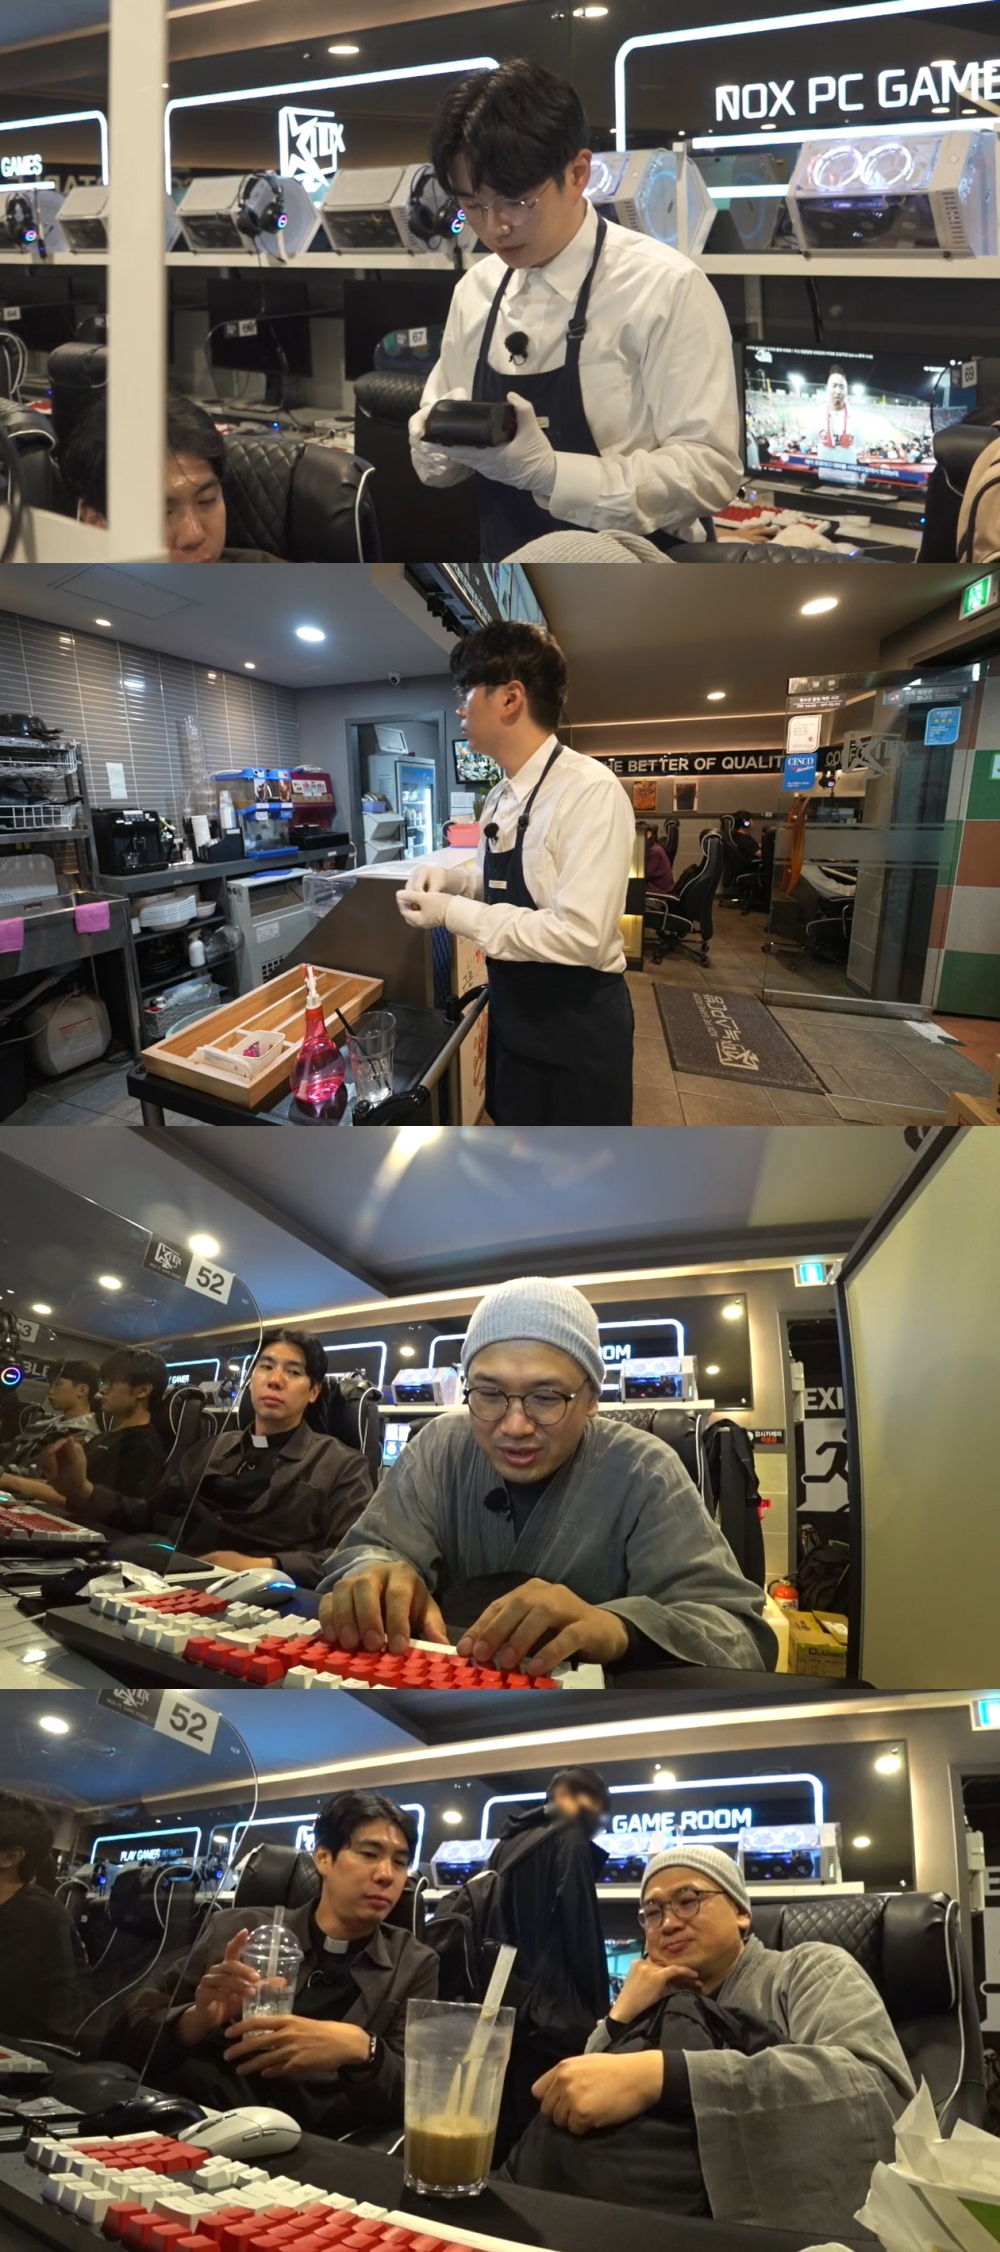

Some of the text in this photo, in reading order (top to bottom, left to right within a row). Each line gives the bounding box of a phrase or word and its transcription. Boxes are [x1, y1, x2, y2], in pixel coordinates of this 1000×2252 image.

[715, 59, 1000, 122] NOX PC GAME
[1, 154, 43, 178] GAMES
[412, 331, 423, 343] 67
[965, 366, 974, 382] 69
[602, 754, 786, 773] HE BETTER OF QUALIT
[787, 756, 814, 767] CESCO
[195, 1265, 225, 1296] 52
[169, 1702, 208, 1743] 52
[612, 1807, 752, 1834] GAME ROOM
[120, 1850, 137, 1862] PLAY
[136, 1848, 161, 1861] GAMES
